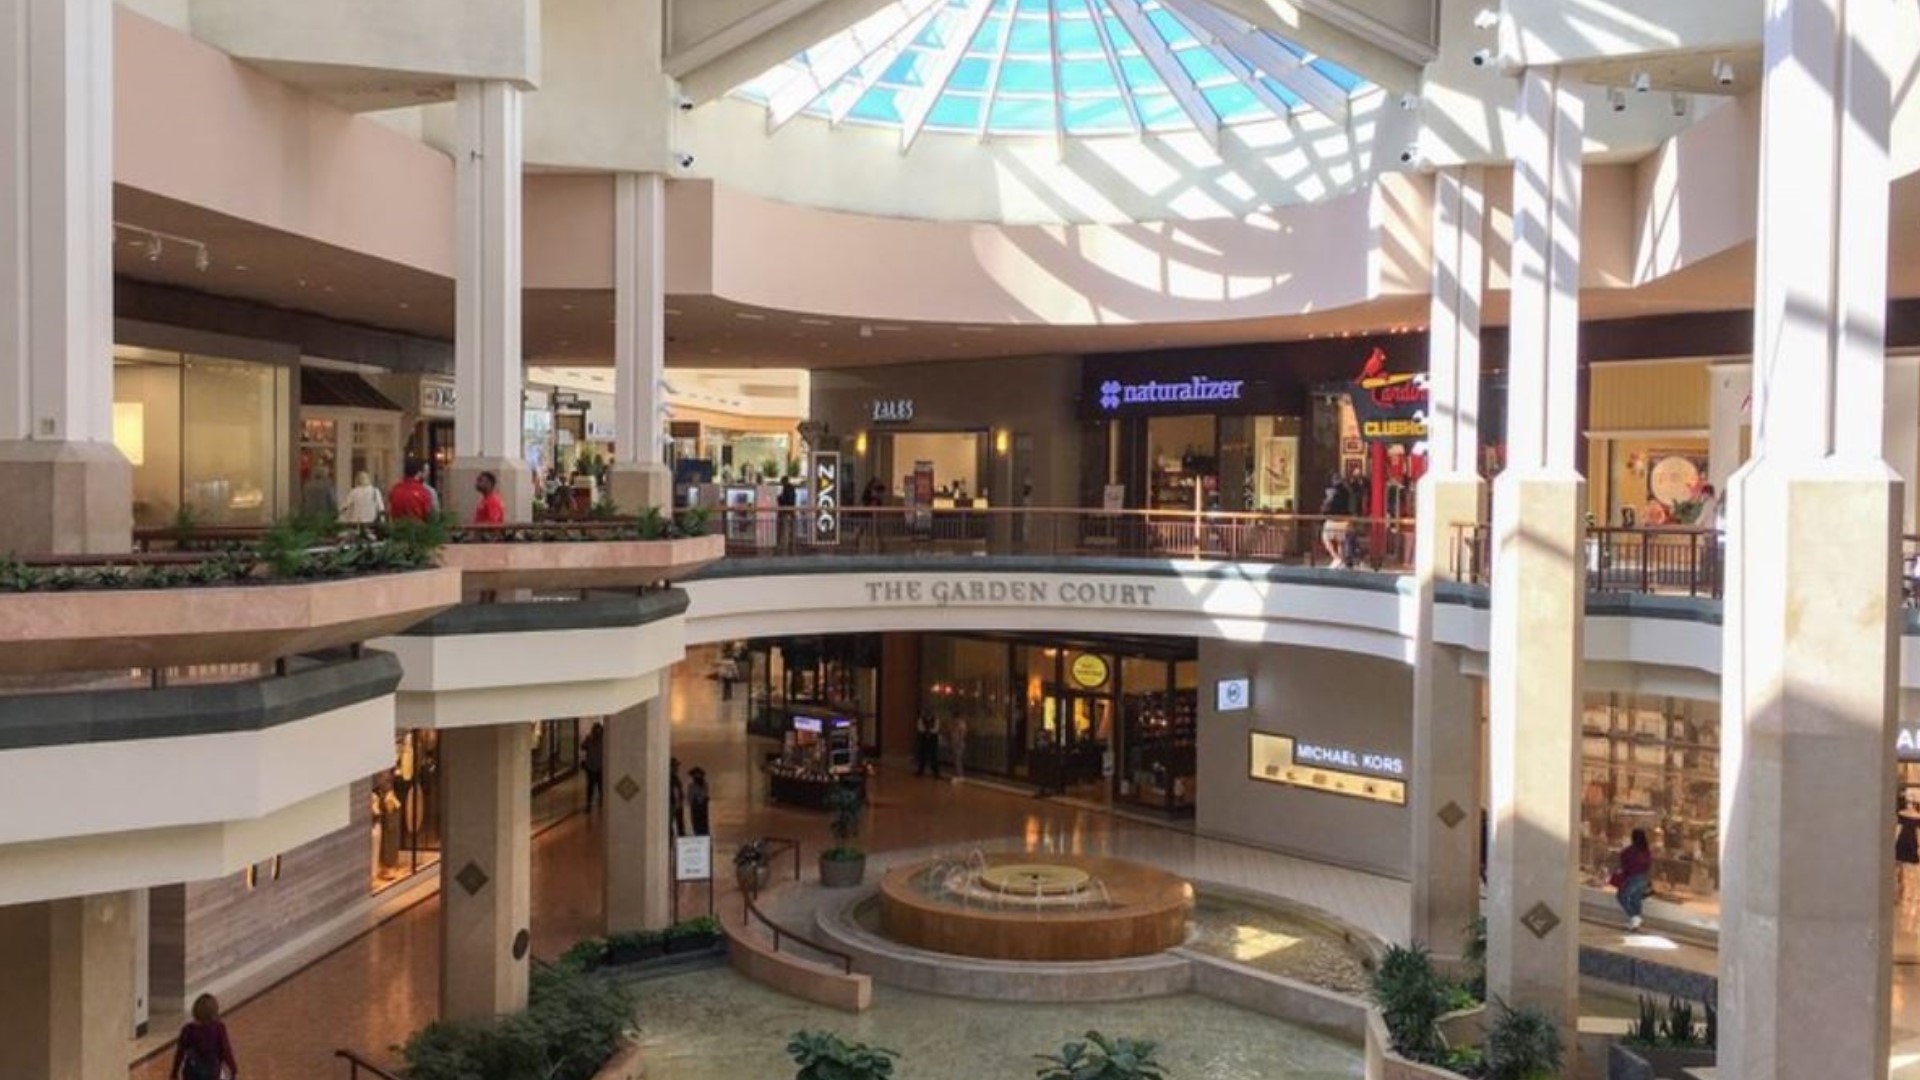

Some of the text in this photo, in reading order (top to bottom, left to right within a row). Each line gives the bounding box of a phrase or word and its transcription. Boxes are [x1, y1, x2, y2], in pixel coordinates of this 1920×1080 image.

[1122, 375, 1244, 403] naturalizer
[872, 399, 913, 421] ZALES
[1364, 421, 1426, 438] CLUBHO
[818, 463, 835, 533] ZAGG
[865, 581, 1156, 607] THE GARDEN COURT
[1298, 744, 1402, 774] MICHAEL KORS
